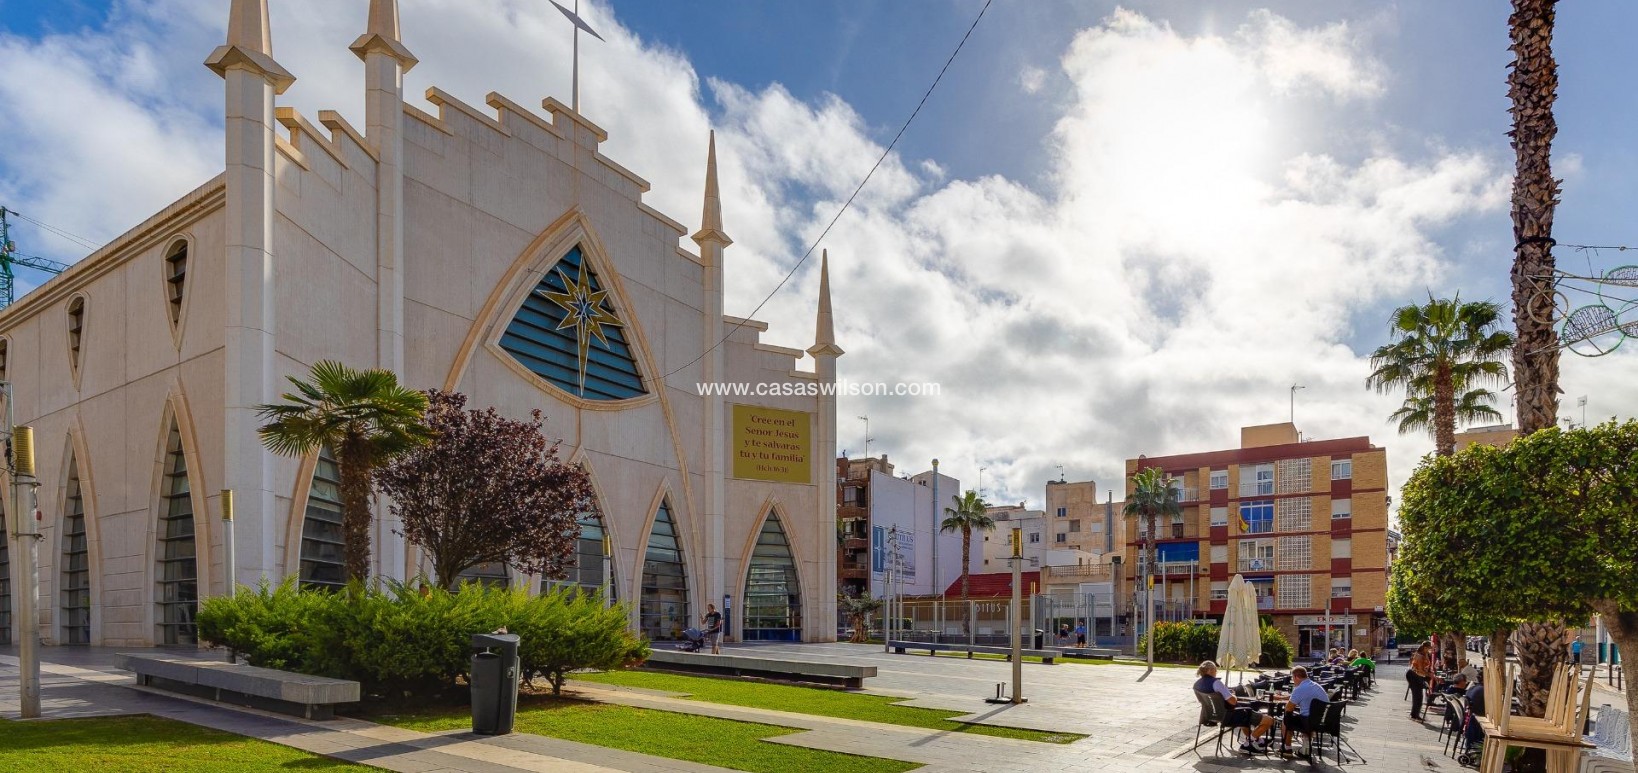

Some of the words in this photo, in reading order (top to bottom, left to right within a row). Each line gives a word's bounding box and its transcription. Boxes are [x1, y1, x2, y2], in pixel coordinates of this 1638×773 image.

[773, 418, 785, 426] en
[787, 419, 795, 427] el
[744, 439, 751, 448] y
[752, 439, 762, 447] te
[759, 452, 770, 460] tu
